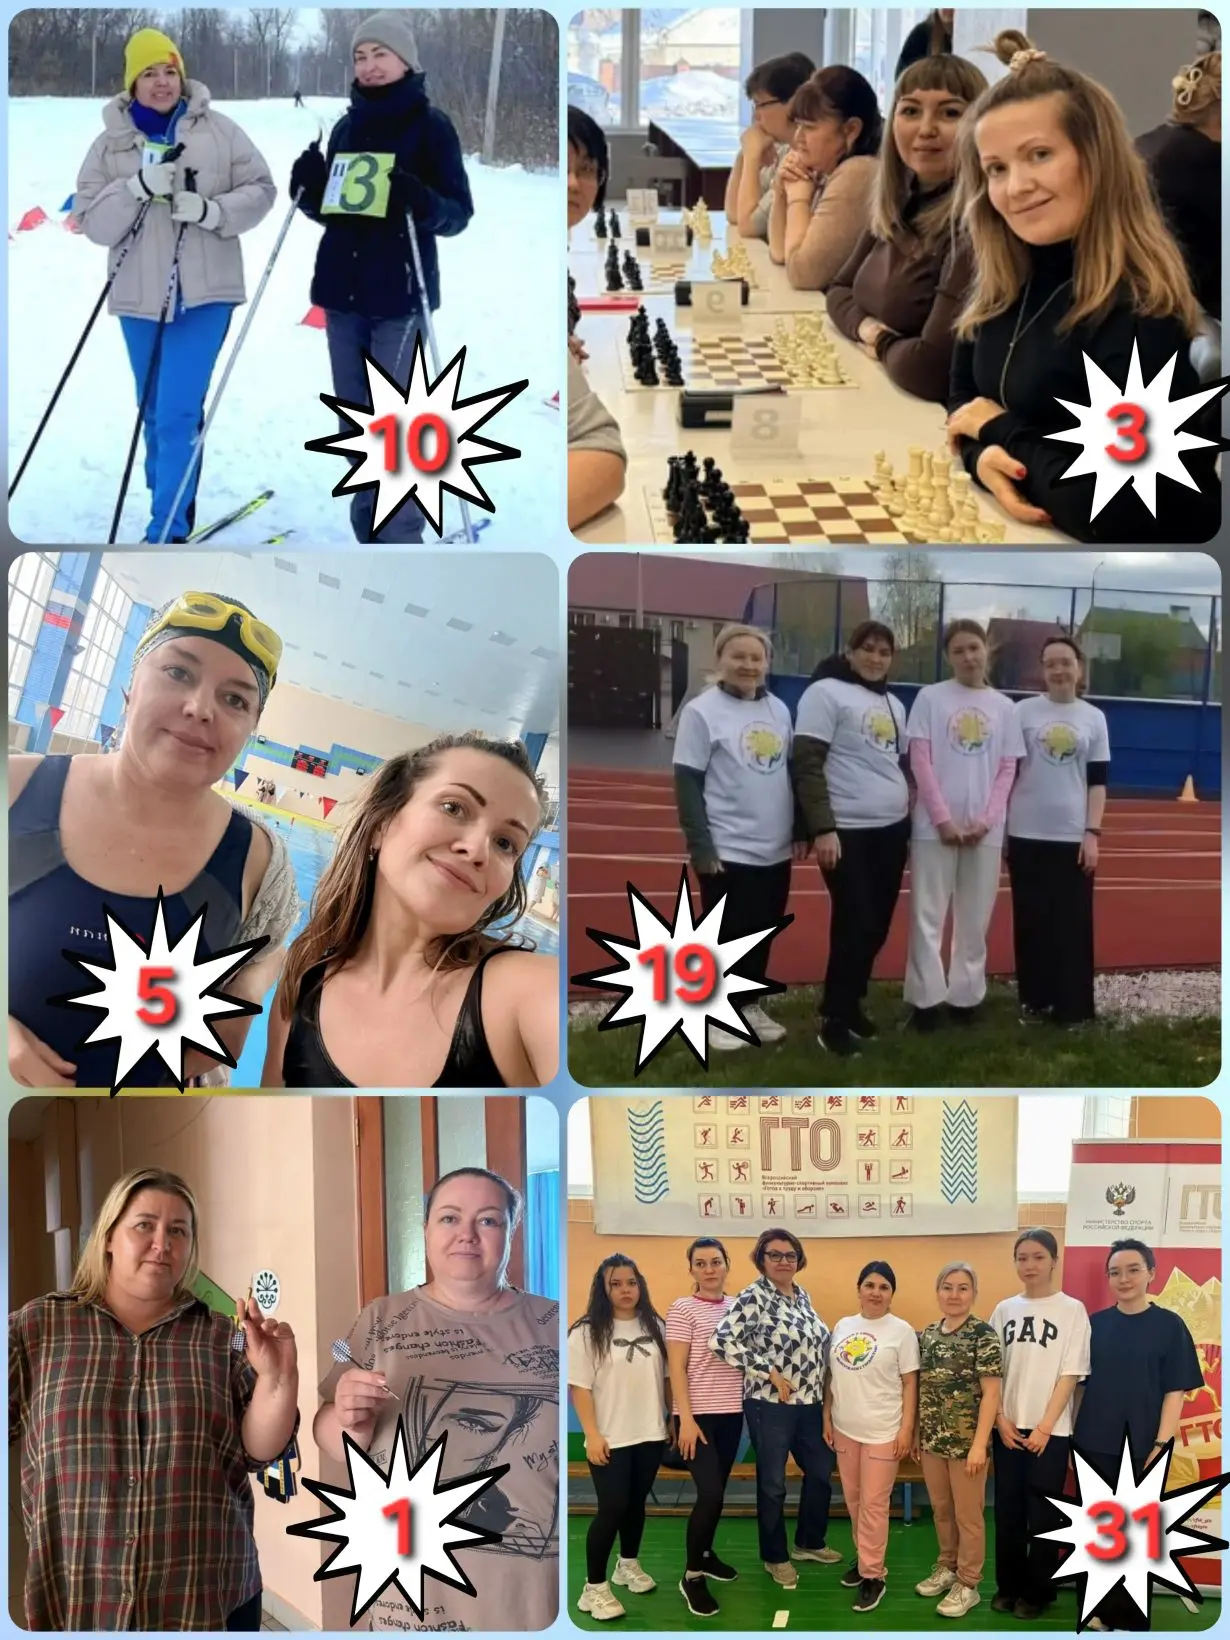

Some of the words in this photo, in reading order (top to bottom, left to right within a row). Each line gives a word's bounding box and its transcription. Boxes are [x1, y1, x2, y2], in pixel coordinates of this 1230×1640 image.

[339, 154, 379, 212] 3
[759, 1116, 842, 1172] ГТО
[383, 1342, 431, 1354] changes
[435, 1337, 482, 1349] Fashion
[1002, 1316, 1058, 1349] GAP
